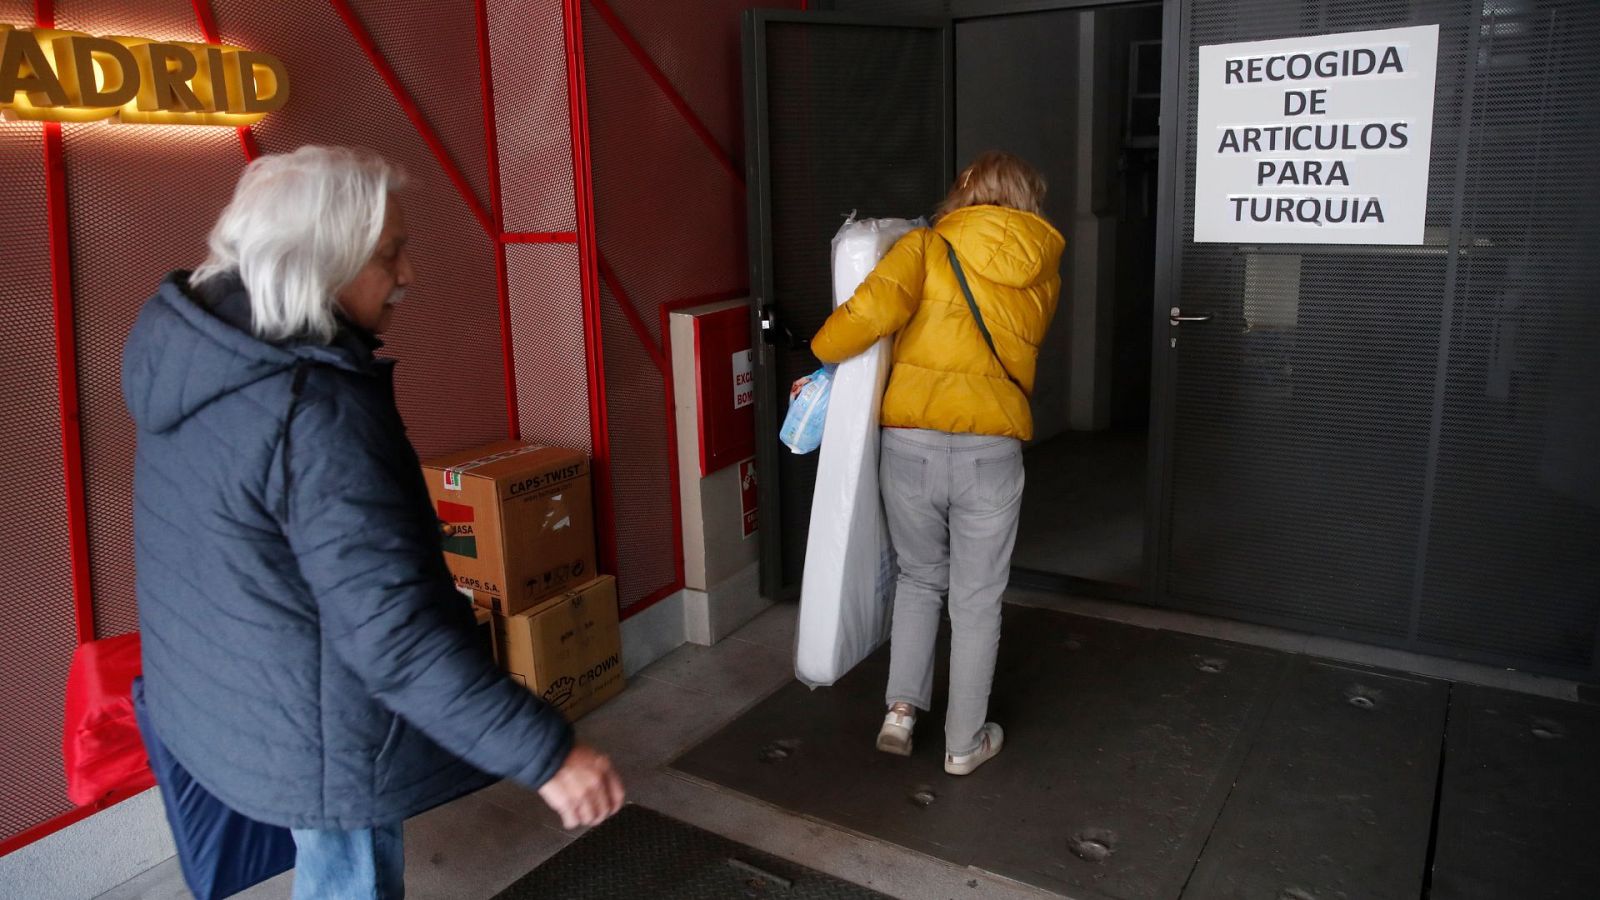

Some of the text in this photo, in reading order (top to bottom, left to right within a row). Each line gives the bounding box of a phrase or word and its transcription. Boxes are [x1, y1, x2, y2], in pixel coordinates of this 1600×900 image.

[1224, 46, 1404, 84] RECOGIDA
[1283, 88, 1327, 116] DE
[1217, 121, 1409, 154] ARTICULOS
[1257, 160, 1350, 187] PARA
[1229, 196, 1385, 227] TURQUIA
[509, 464, 580, 495] CAPS-TWIST
[578, 652, 619, 687] CROWN
